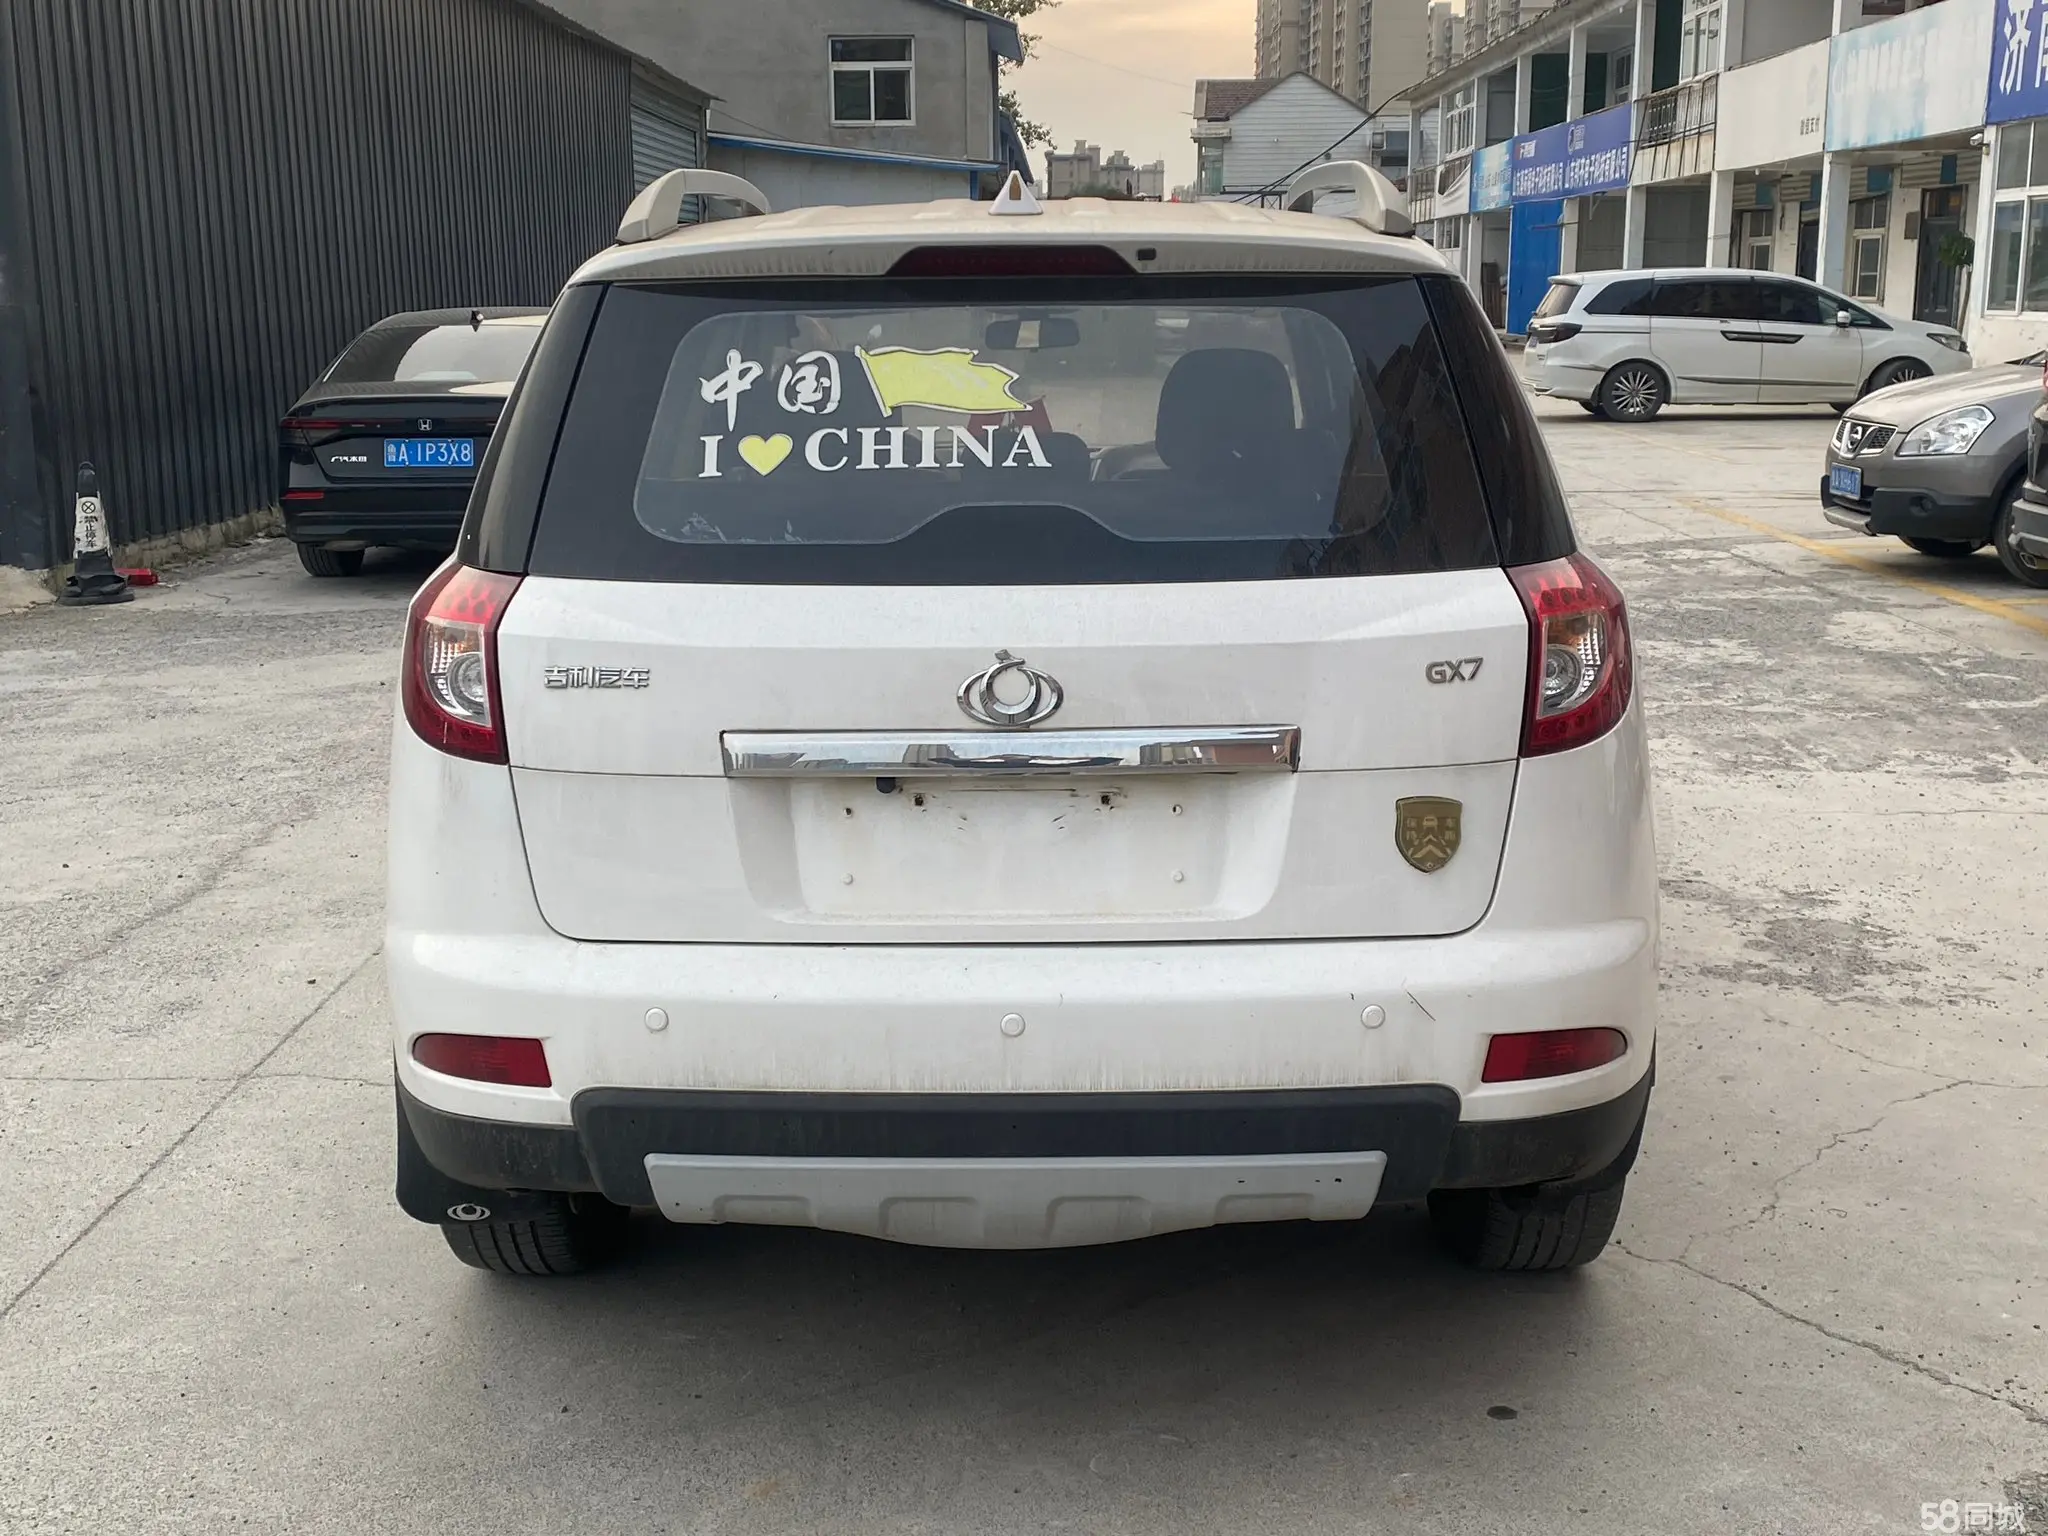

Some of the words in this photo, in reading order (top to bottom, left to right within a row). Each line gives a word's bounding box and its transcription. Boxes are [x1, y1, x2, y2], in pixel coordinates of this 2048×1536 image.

[1999, 0, 2048, 96] 济
[698, 348, 841, 431] 中国
[698, 434, 724, 478] I
[804, 424, 1052, 472] CHINA
[84, 515, 98, 549] 禁止停车
[544, 665, 650, 689] 吉利汽车
[1425, 656, 1484, 685] GX7
